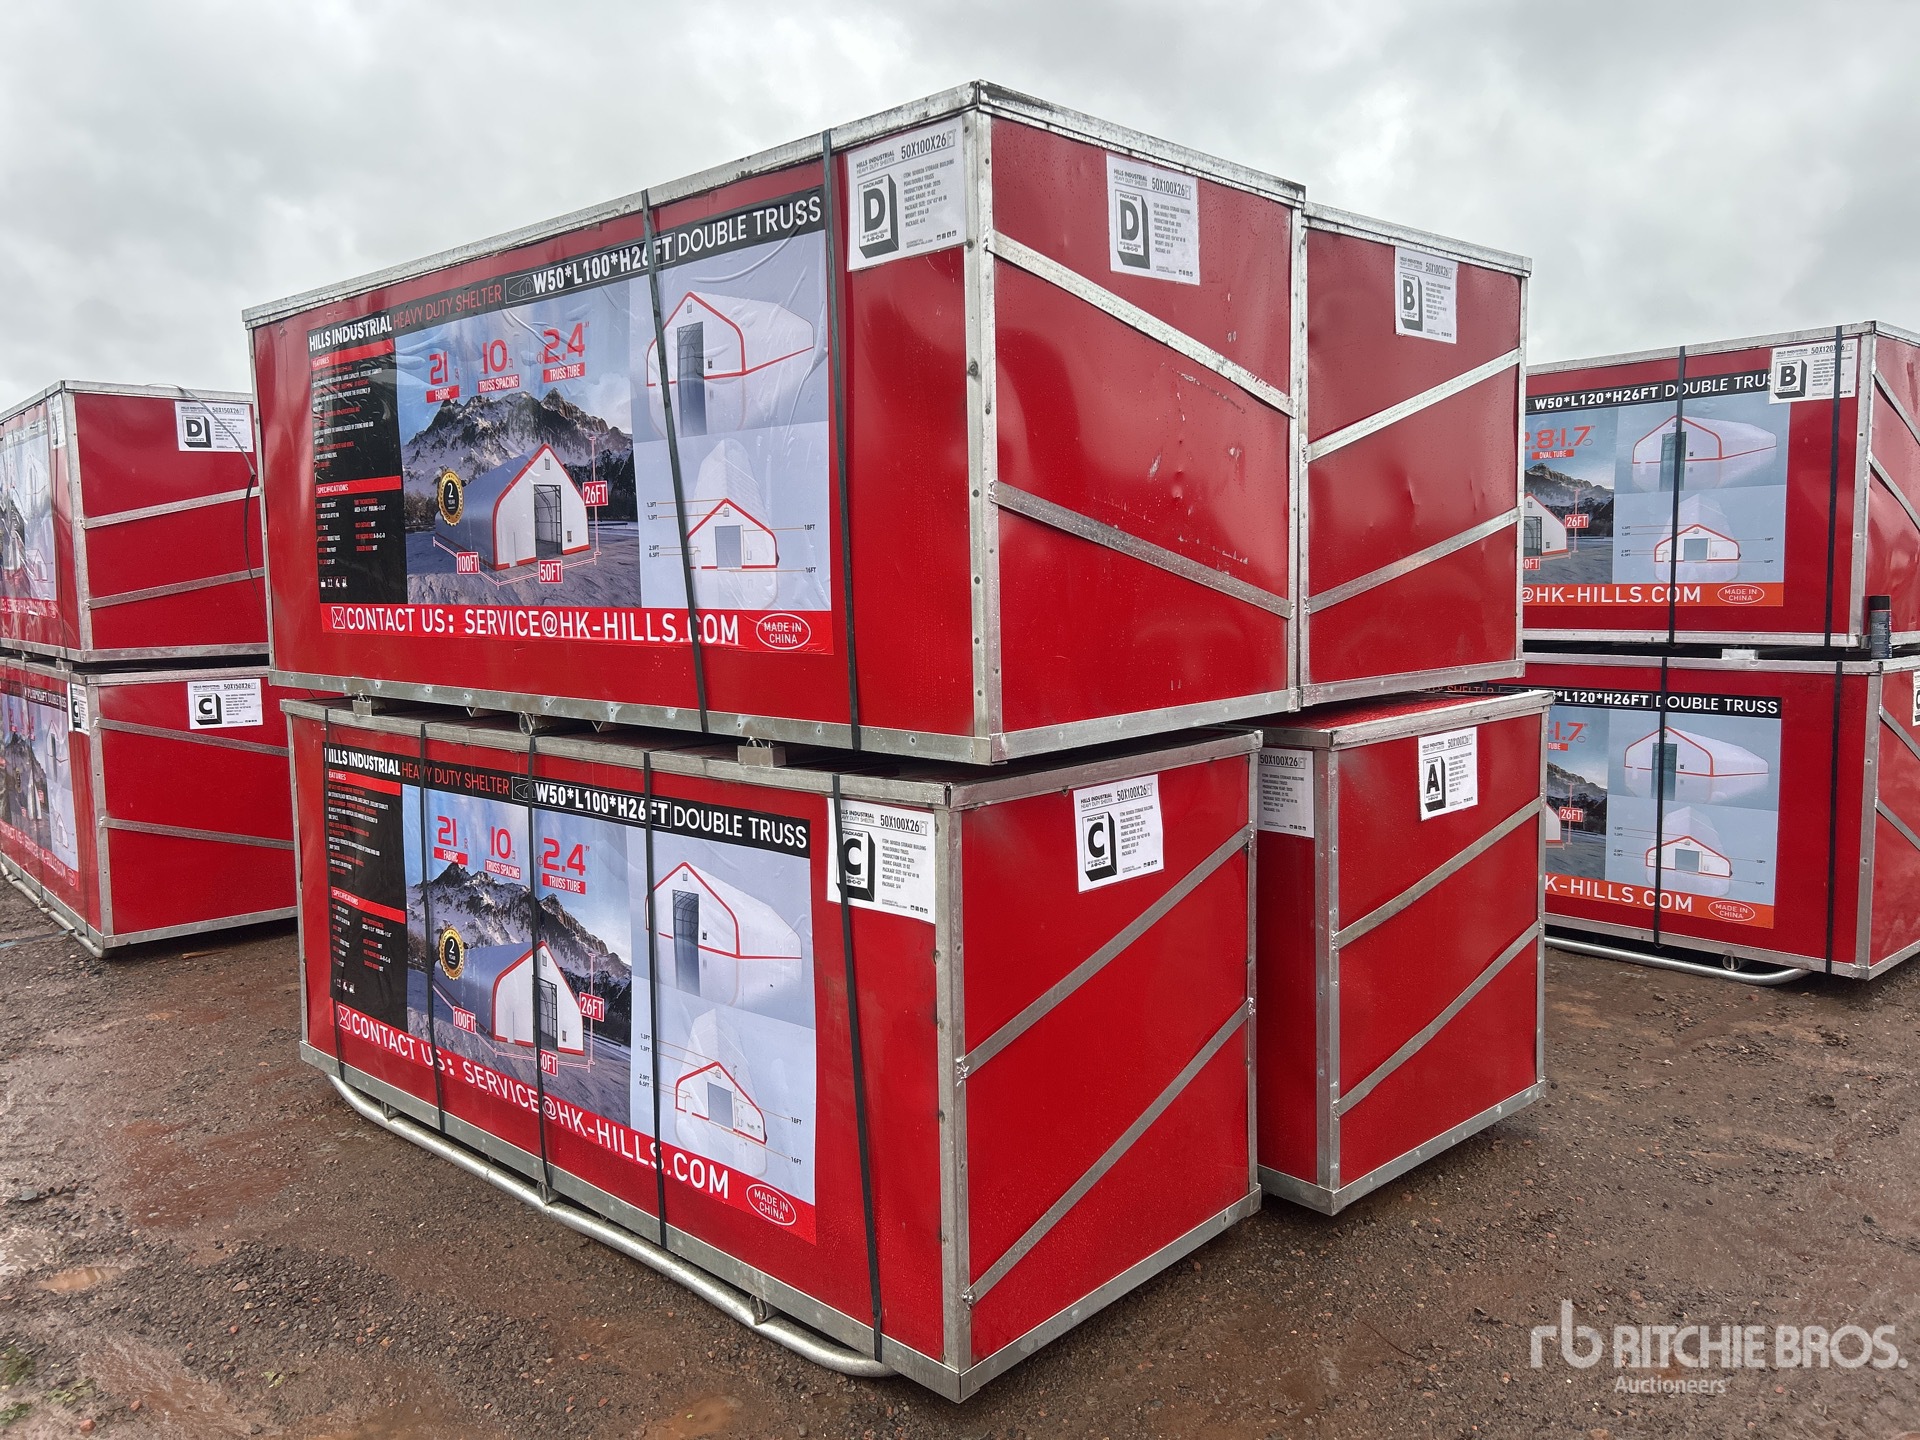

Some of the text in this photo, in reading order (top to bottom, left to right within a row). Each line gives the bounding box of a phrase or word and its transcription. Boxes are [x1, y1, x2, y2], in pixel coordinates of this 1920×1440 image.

[868, 148, 894, 164] INDUSTRIAL
[863, 185, 886, 232] D
[1119, 199, 1139, 242] D
[309, 331, 330, 352] HILLS
[332, 315, 392, 345] INDUSTRIAL
[394, 305, 423, 330] HEAVY
[426, 297, 453, 320] DUTY
[456, 284, 502, 312] SHELTER
[678, 215, 747, 256] DOUBLE
[753, 196, 822, 236] TRUSS
[1403, 280, 1415, 310] B
[482, 340, 508, 374] 10
[430, 351, 448, 386] 21
[550, 364, 581, 381] TRUSS TUBE
[1780, 366, 1796, 387] B
[478, 376, 519, 392] TRUSS SPACING
[1665, 378, 1729, 397] DOUBLE
[186, 420, 202, 437] D
[317, 484, 349, 494] SPECIFICATIONS
[447, 483, 454, 498] 2
[585, 485, 608, 504] 26FT
[1566, 516, 1588, 527] 26FT
[458, 554, 479, 573] 100FT
[540, 562, 562, 582] 50FT
[1523, 558, 1538, 569] 0FT
[347, 607, 739, 645] CONTACT US: SERVICE@HK-HILLS.COM
[764, 622, 802, 632] MADE IN
[769, 634, 798, 644] CHINA
[199, 698, 212, 714] C
[1724, 699, 1778, 714] TRUSS
[328, 771, 346, 780] EATURES
[1426, 764, 1440, 794] A
[348, 751, 400, 776] INDUSTRIAL
[434, 768, 461, 787] DUTY
[464, 772, 510, 795] SHELTER
[674, 805, 743, 837] DOUBLE
[748, 816, 807, 849] TRUSS
[849, 810, 874, 818] INDUSTRIAL
[1561, 809, 1582, 821] 26FT
[438, 816, 457, 847] 21
[1086, 820, 1104, 860] C
[490, 826, 512, 860] 10
[843, 836, 861, 876] C
[486, 860, 519, 879] TRUSS SPACING
[549, 875, 581, 892] TRUSS TUBE
[1715, 904, 1737, 912] MADE
[1719, 911, 1744, 919] CHINA
[449, 939, 454, 953] 2
[581, 996, 603, 1019] 26FT
[455, 1010, 476, 1032] 100FT
[352, 1013, 728, 1199] CONTACT US: SERVICE@HK-HILLS.COM
[791, 1156, 802, 1165] 16FT
[754, 1190, 789, 1213] MADE IN
[759, 1202, 785, 1221] CHINA
